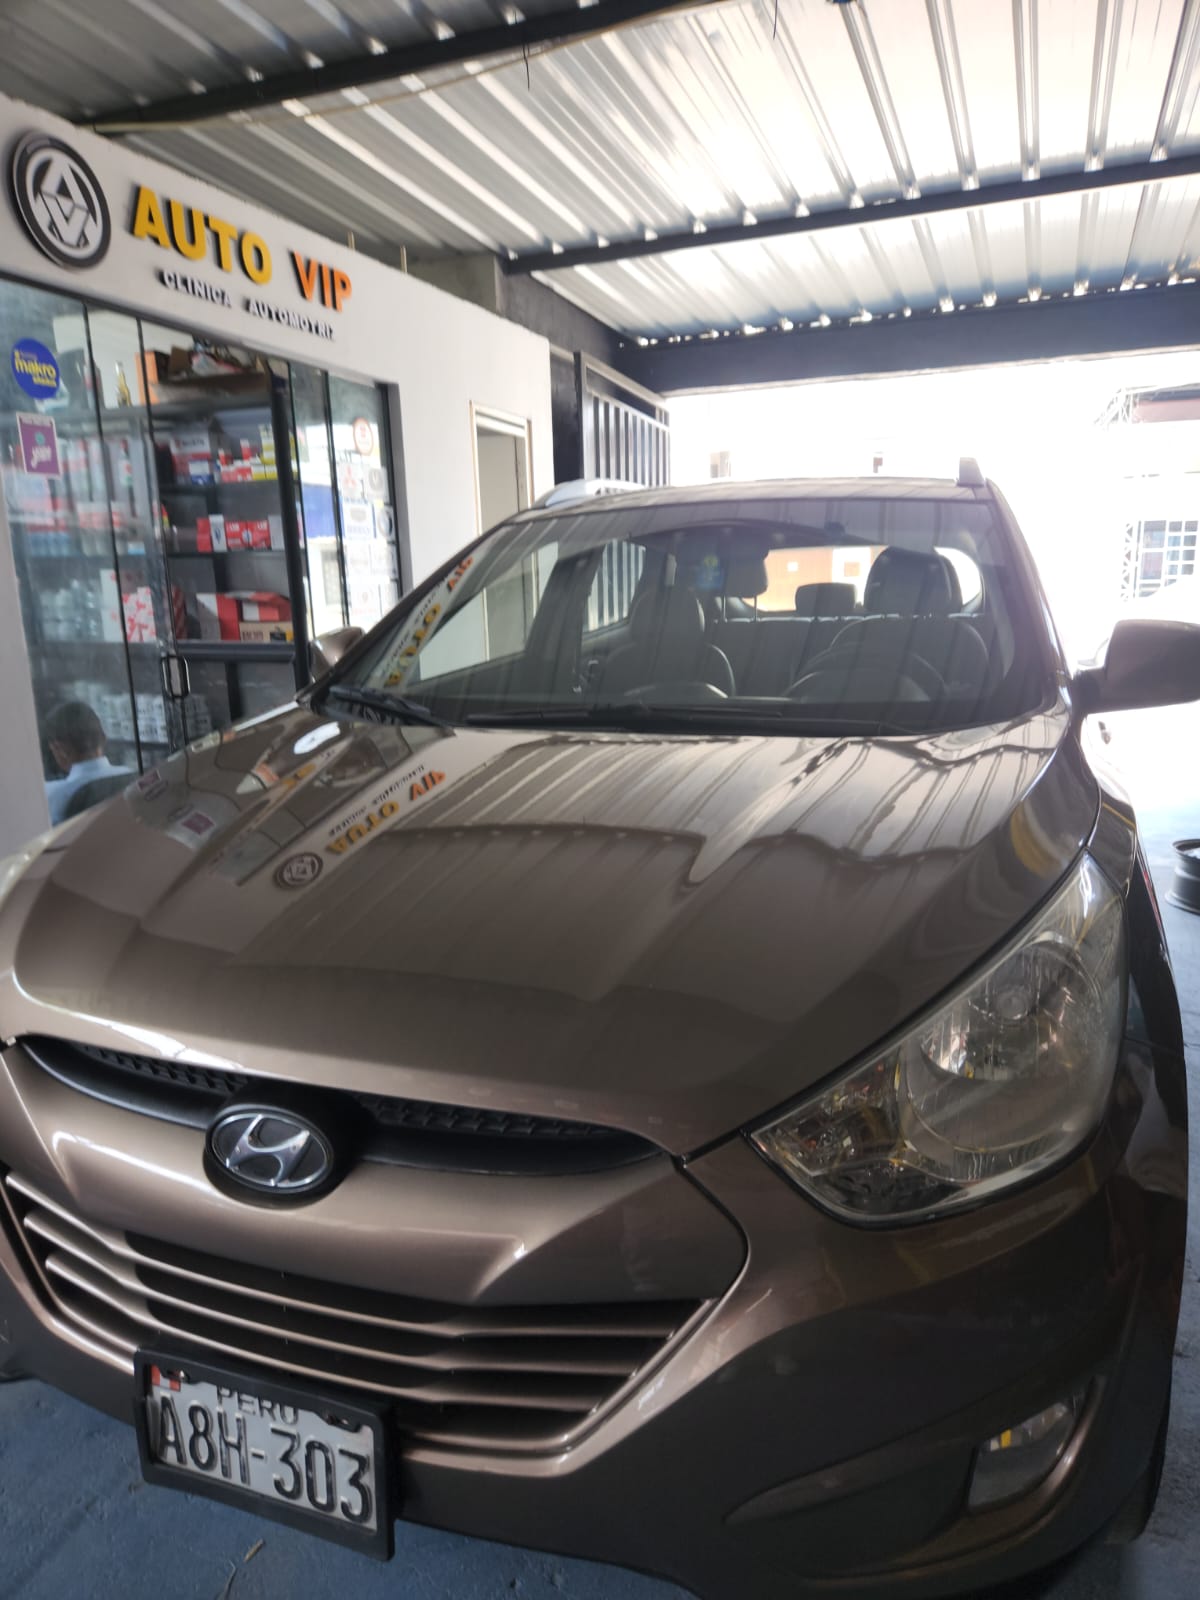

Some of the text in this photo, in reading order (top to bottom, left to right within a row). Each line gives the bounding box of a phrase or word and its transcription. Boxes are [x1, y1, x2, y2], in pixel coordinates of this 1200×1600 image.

[131, 184, 353, 313] AUTO VIP
[159, 269, 232, 308] CLINICA
[158, 1391, 375, 1525] A8H-303
